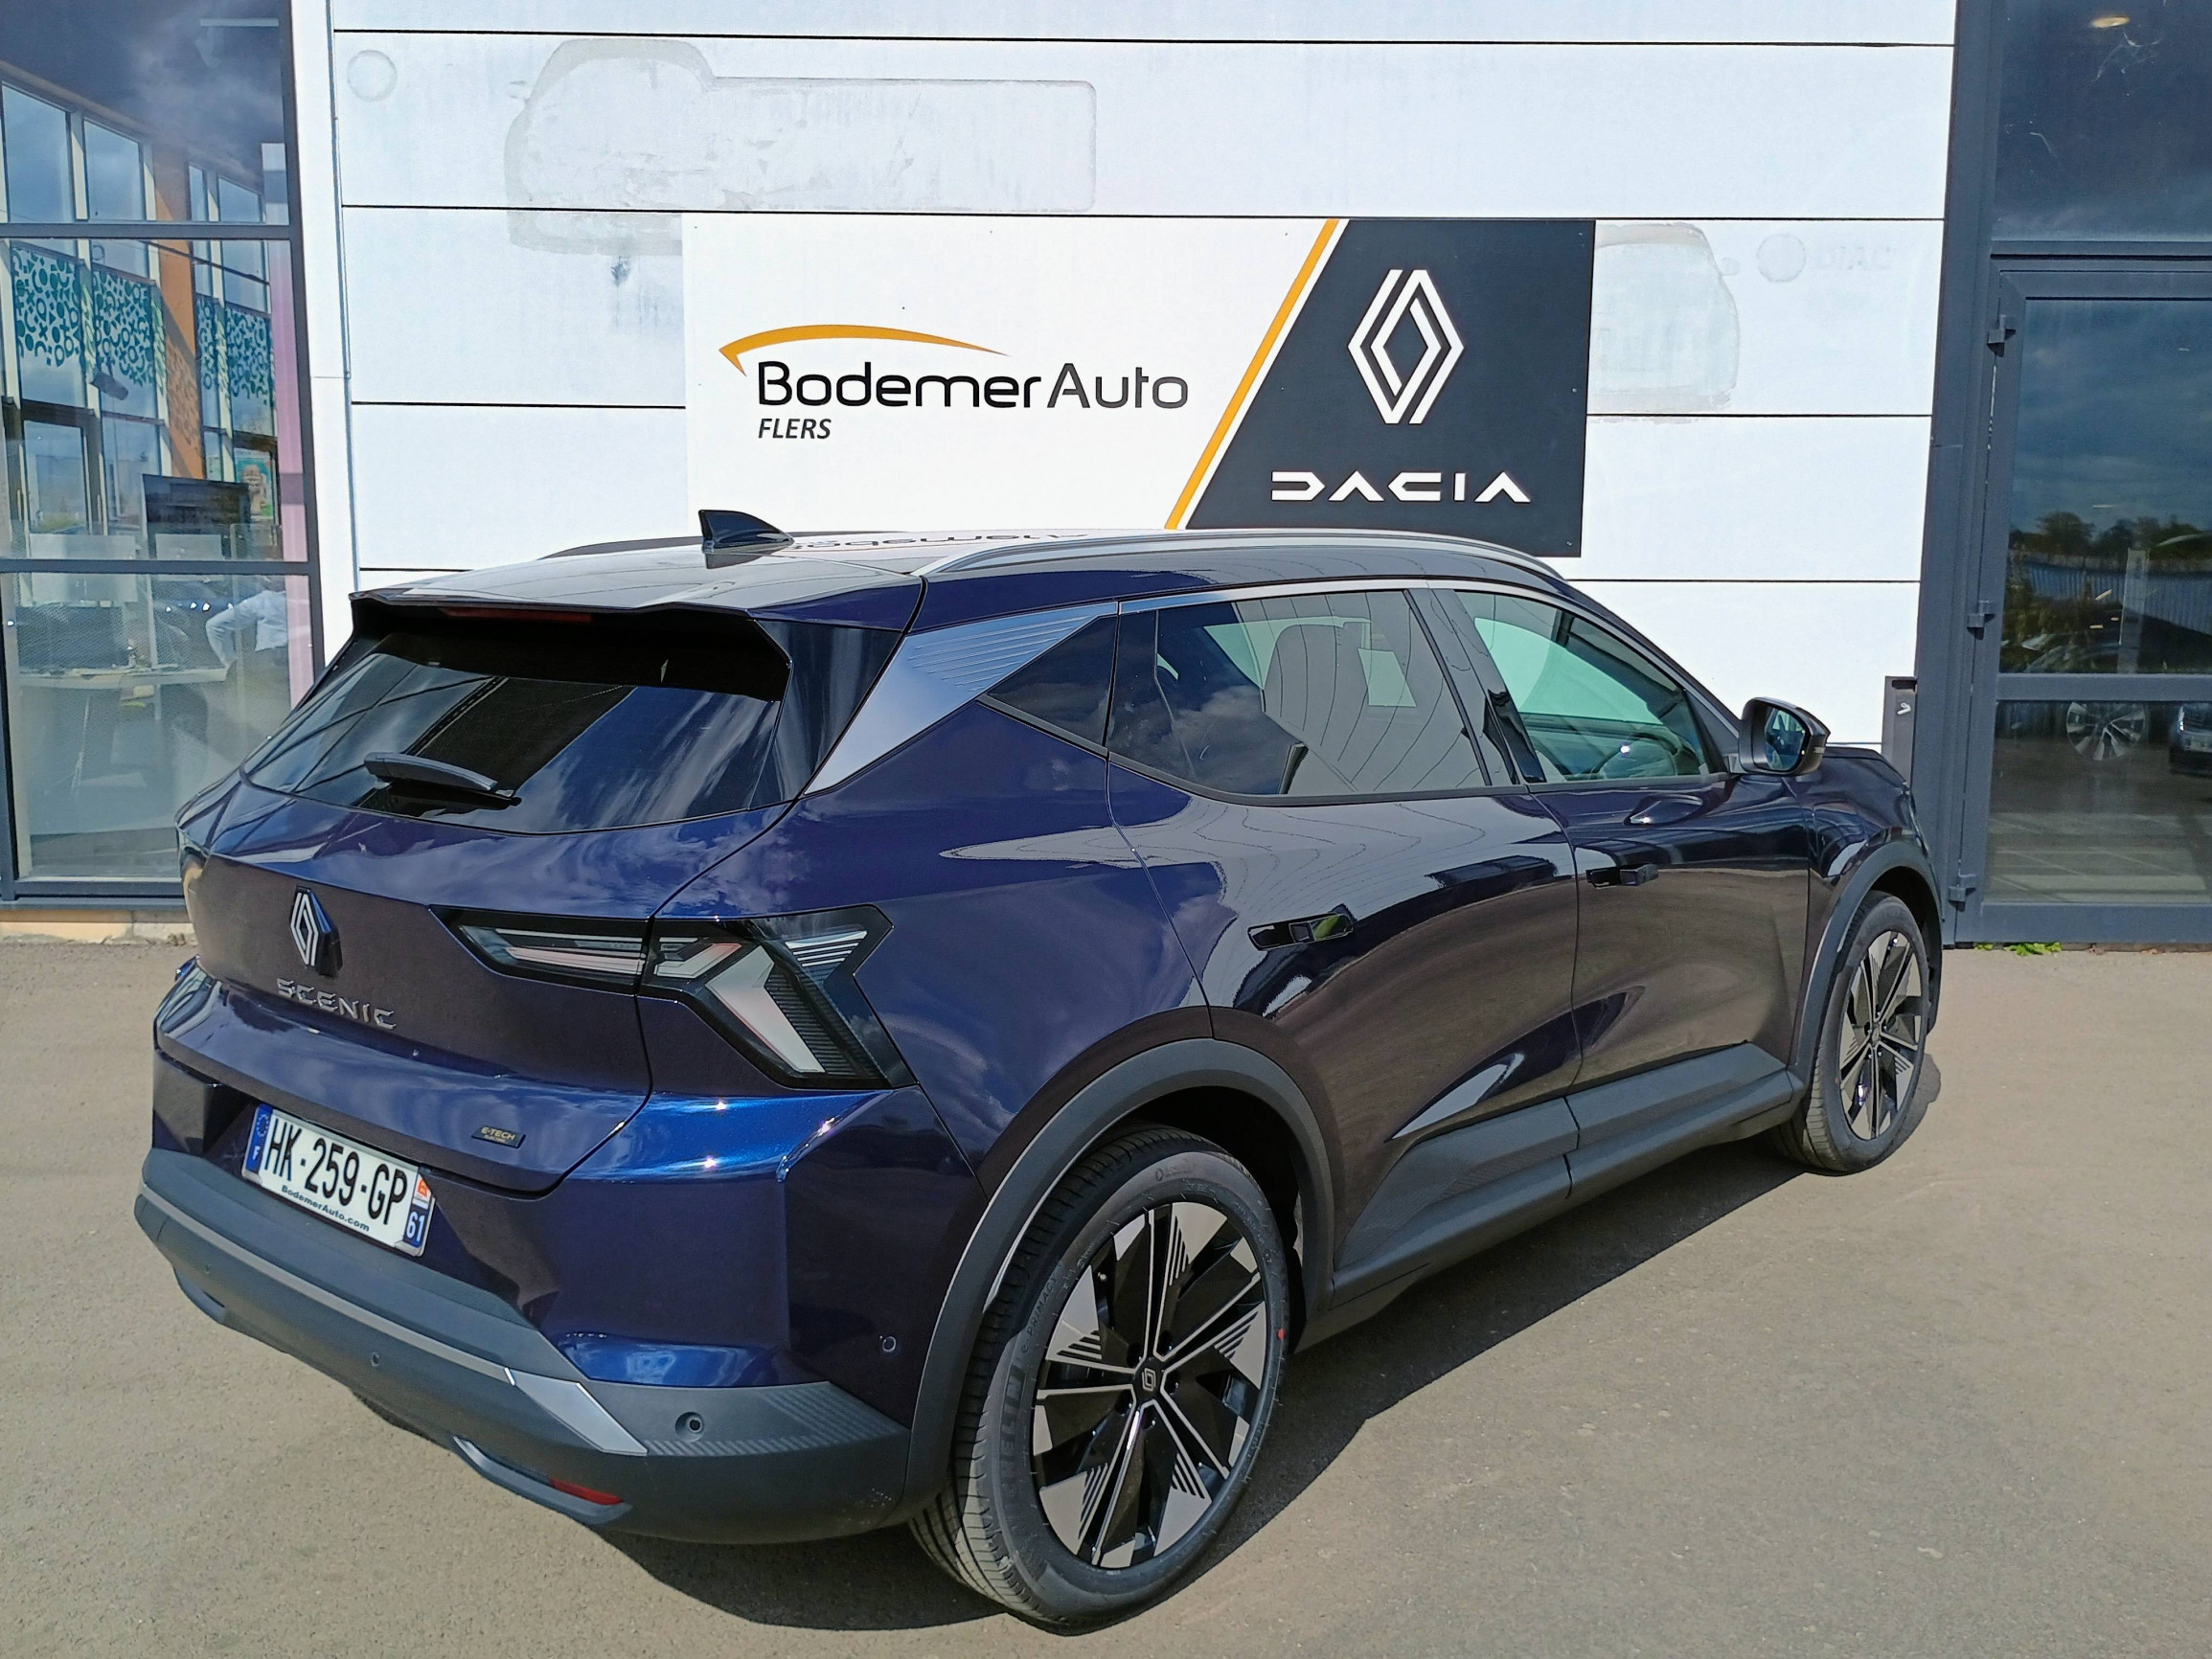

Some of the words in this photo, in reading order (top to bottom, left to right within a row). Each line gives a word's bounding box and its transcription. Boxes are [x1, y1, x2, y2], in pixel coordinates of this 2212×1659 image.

[758, 418, 832, 440] FLERS
[1271, 470, 1531, 503] DACIA
[277, 978, 397, 1030] SCENIC
[252, 1146, 261, 1161] F
[264, 1118, 407, 1225] HK-259-GP
[281, 1184, 370, 1233] BodemerAuto.com
[406, 1211, 425, 1242] 61
